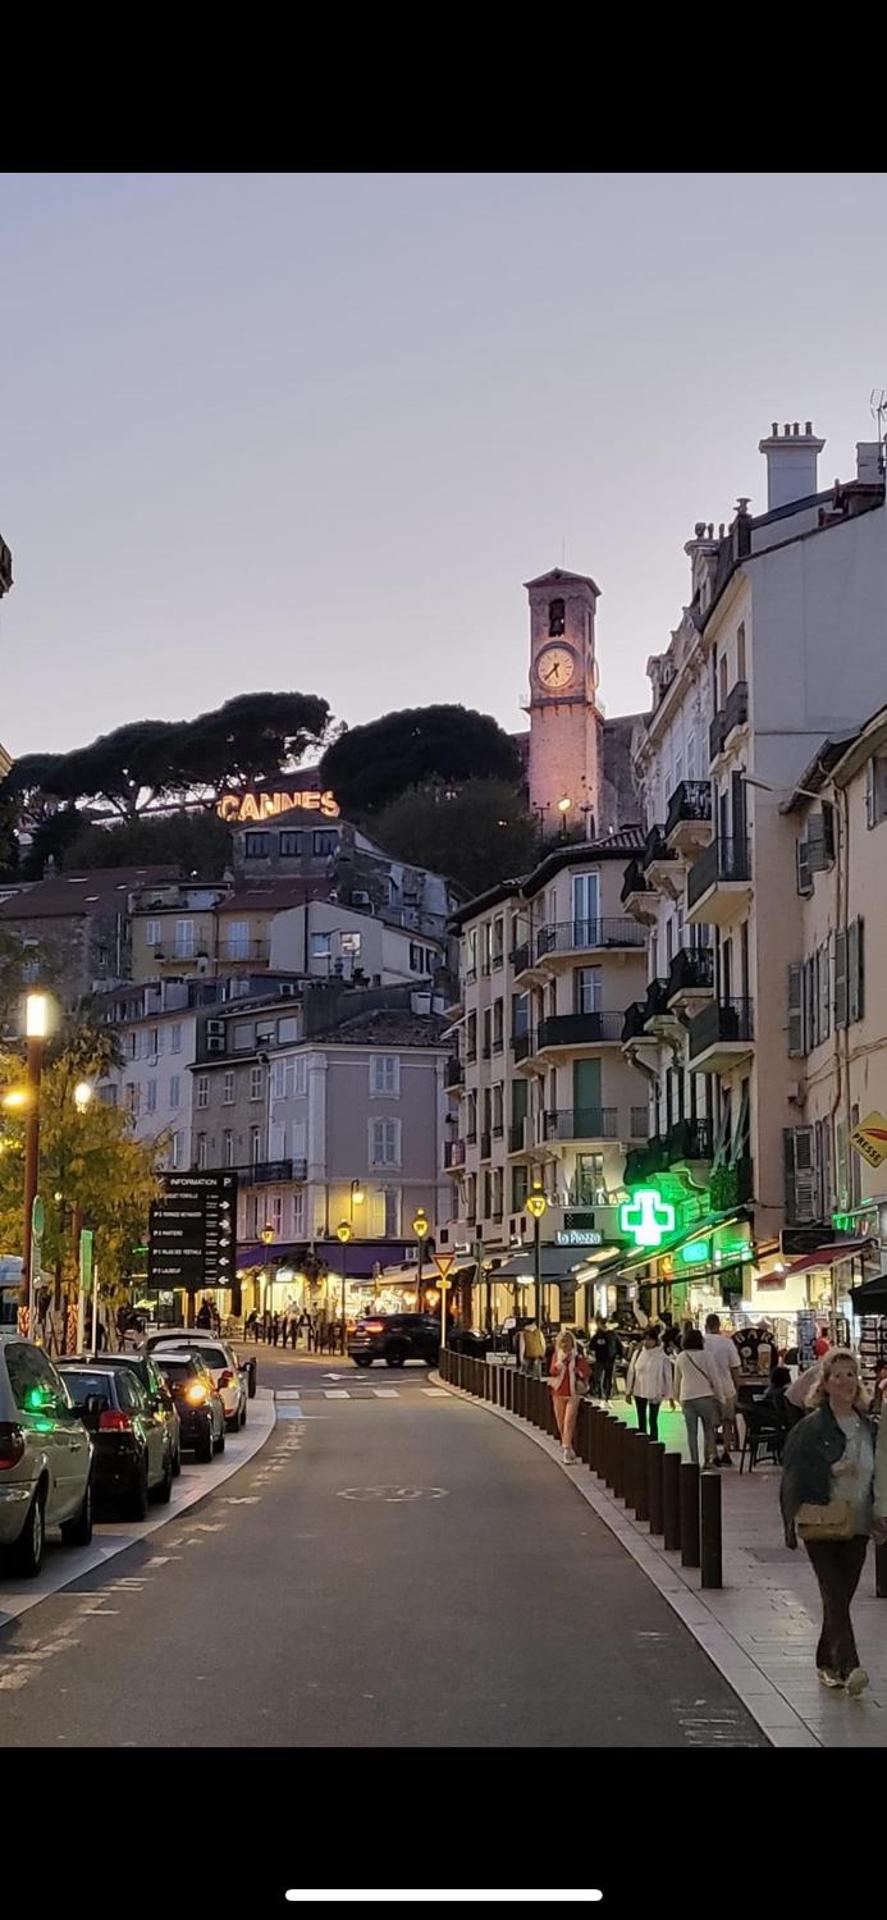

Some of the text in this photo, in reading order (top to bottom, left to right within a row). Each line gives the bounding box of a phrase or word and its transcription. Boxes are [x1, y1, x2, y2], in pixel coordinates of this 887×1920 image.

[216, 790, 340, 821] CANNES
[852, 1132, 882, 1162] PRESSE
[170, 1177, 232, 1187] INFORMATION P
[557, 1230, 601, 1245] La Piazza
